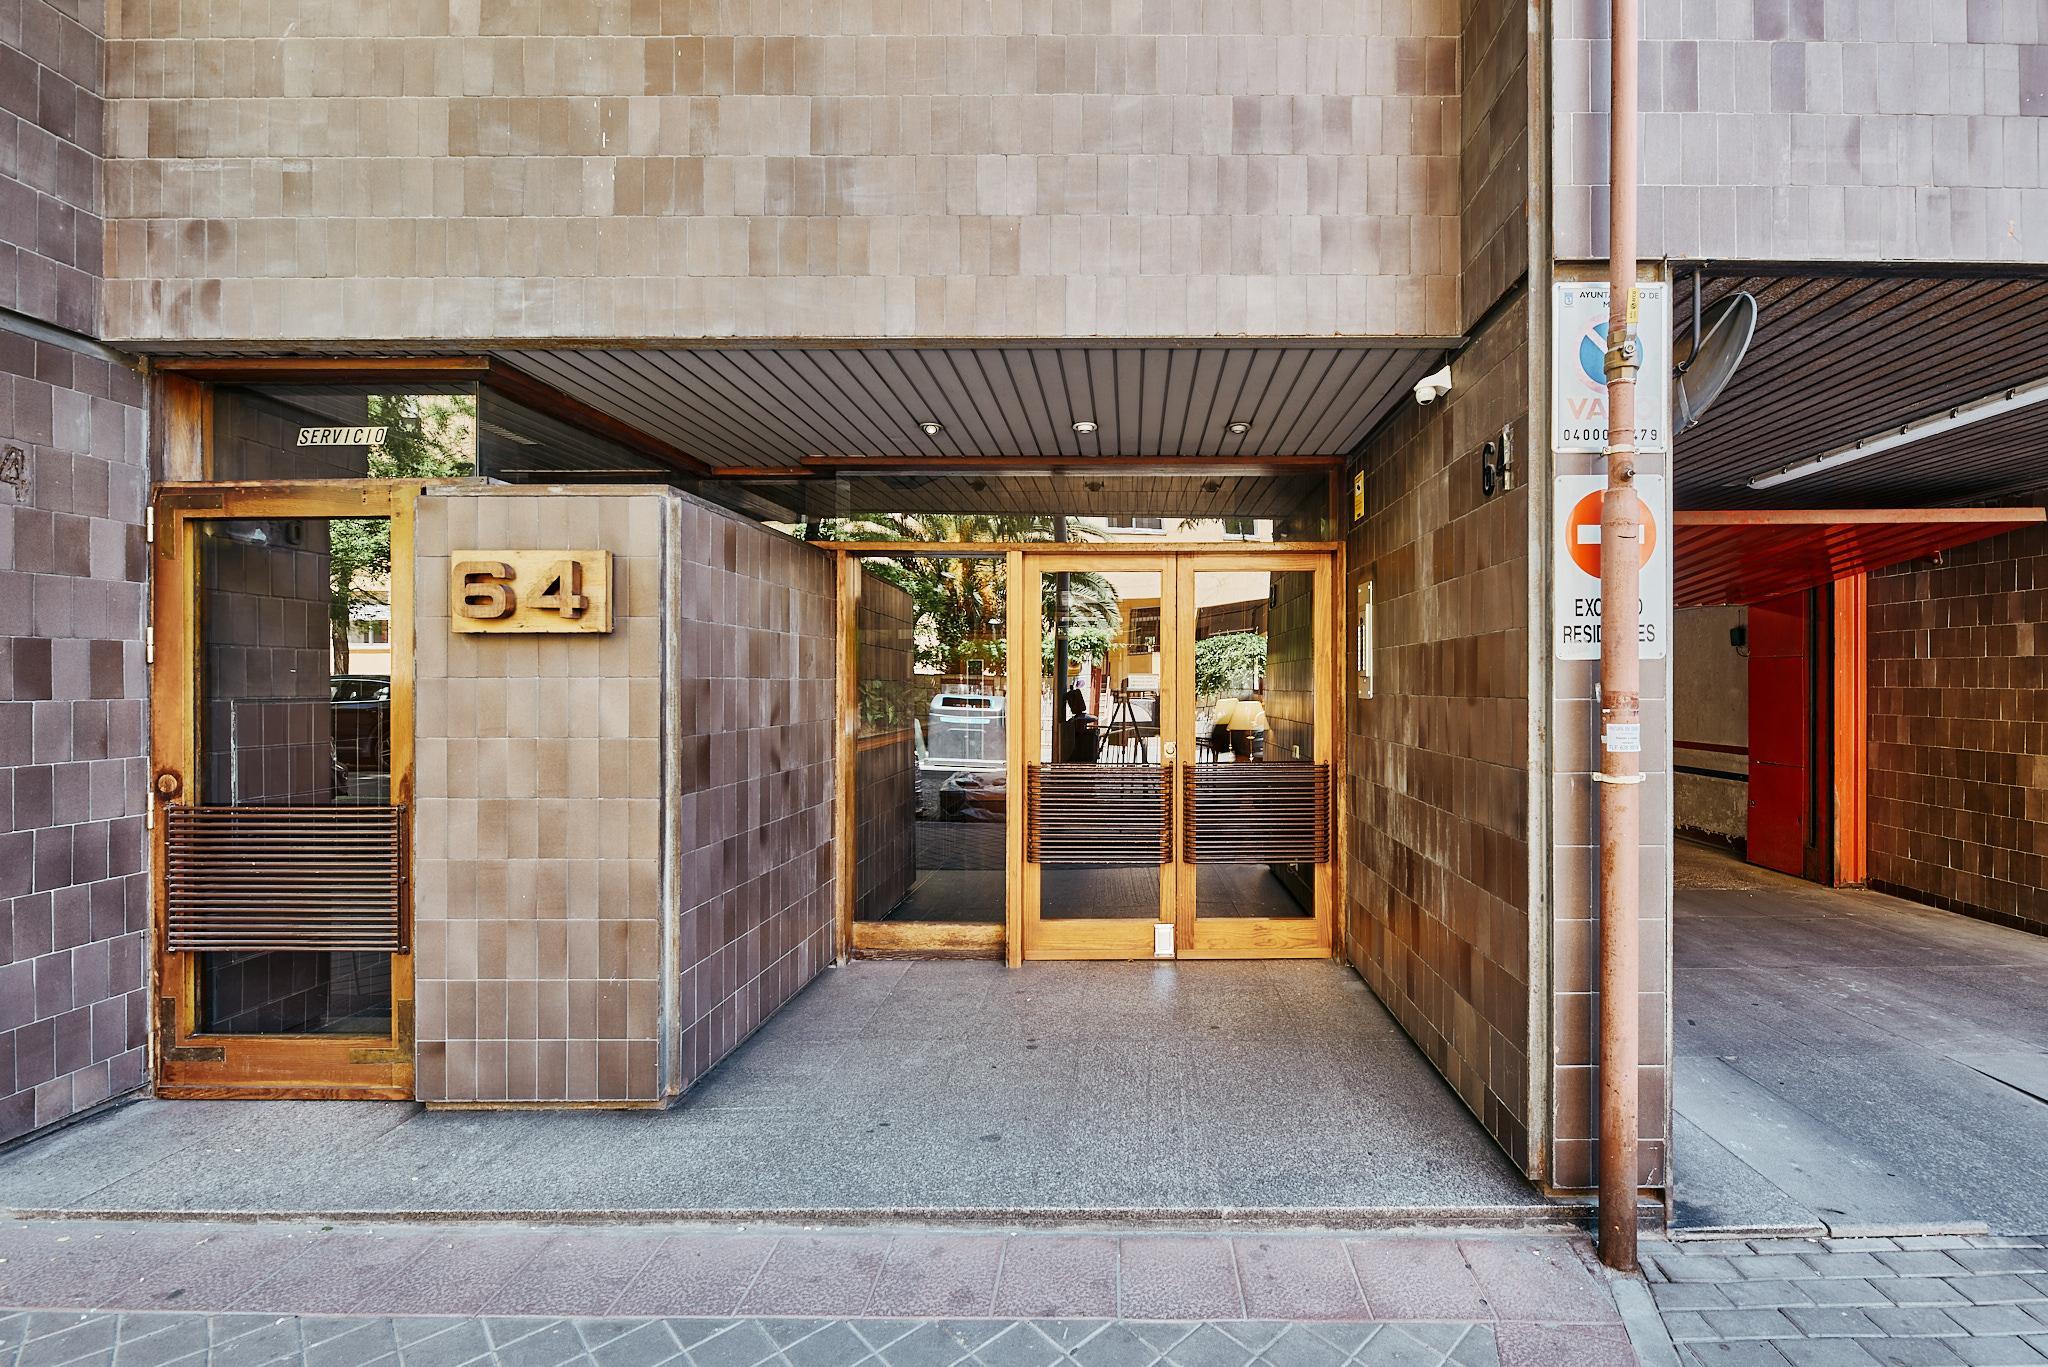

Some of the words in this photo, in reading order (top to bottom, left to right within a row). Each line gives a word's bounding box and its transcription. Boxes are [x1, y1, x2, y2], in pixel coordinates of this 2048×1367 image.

[1579, 291, 1646, 299] AYUNTO
[299, 428, 385, 444] SERVICIO
[1563, 429, 1658, 441] 0400079
[452, 560, 589, 619] 64
[1563, 624, 1655, 644] RESIES
